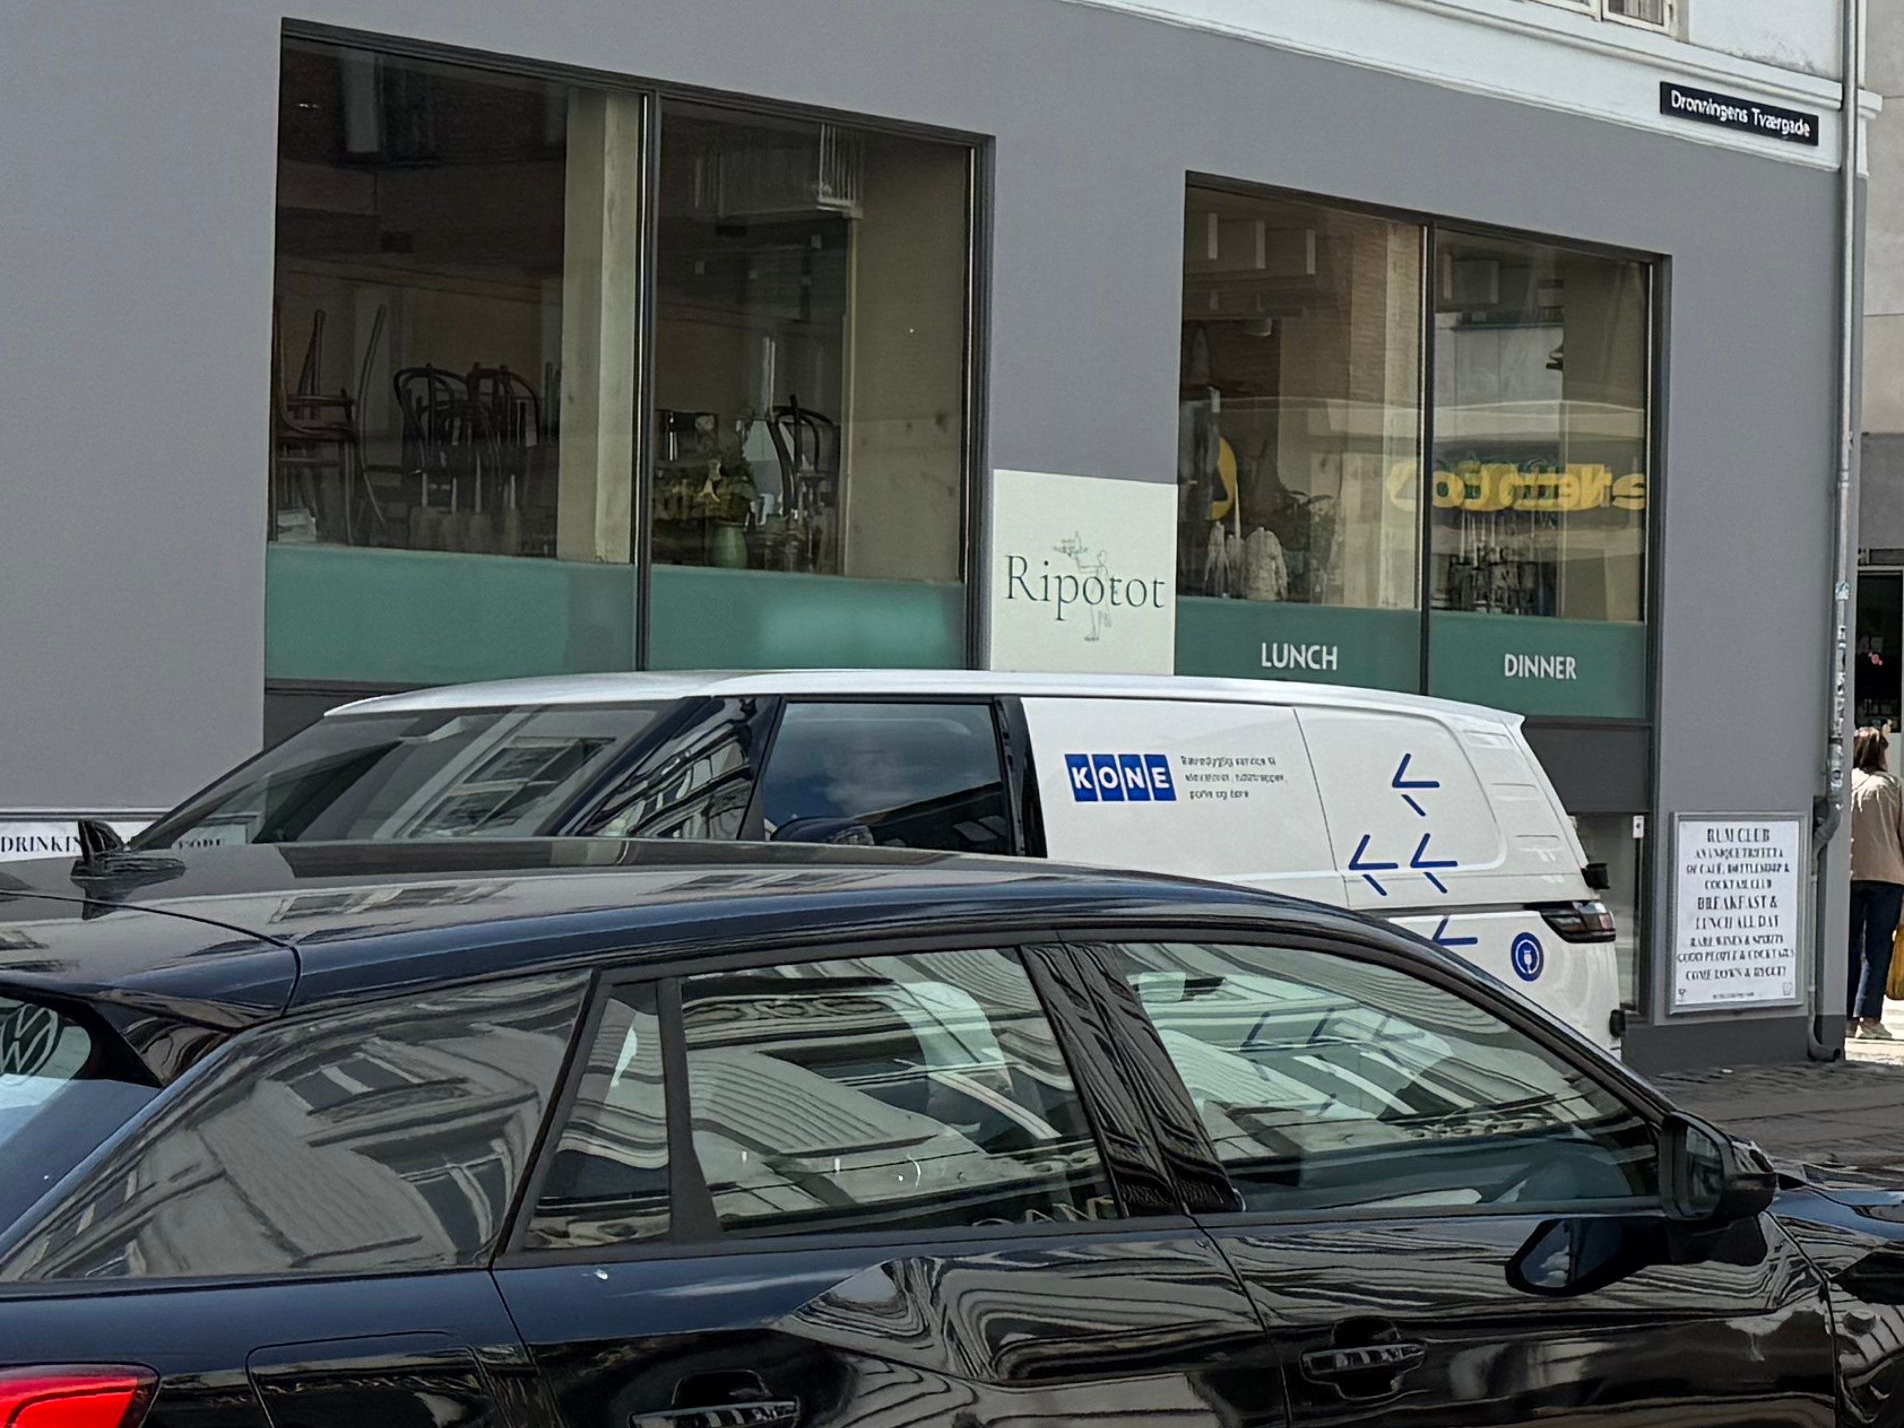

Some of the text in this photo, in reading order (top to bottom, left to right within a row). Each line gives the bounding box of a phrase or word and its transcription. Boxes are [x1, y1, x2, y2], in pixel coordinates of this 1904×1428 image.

[1671, 89, 1811, 137] Dronningens Tværgade
[1005, 555, 1166, 621] Ripotot
[1261, 641, 1338, 671] LUNCH
[1504, 653, 1577, 681] DINNER
[1697, 895, 1778, 910] BREAKFAST &
